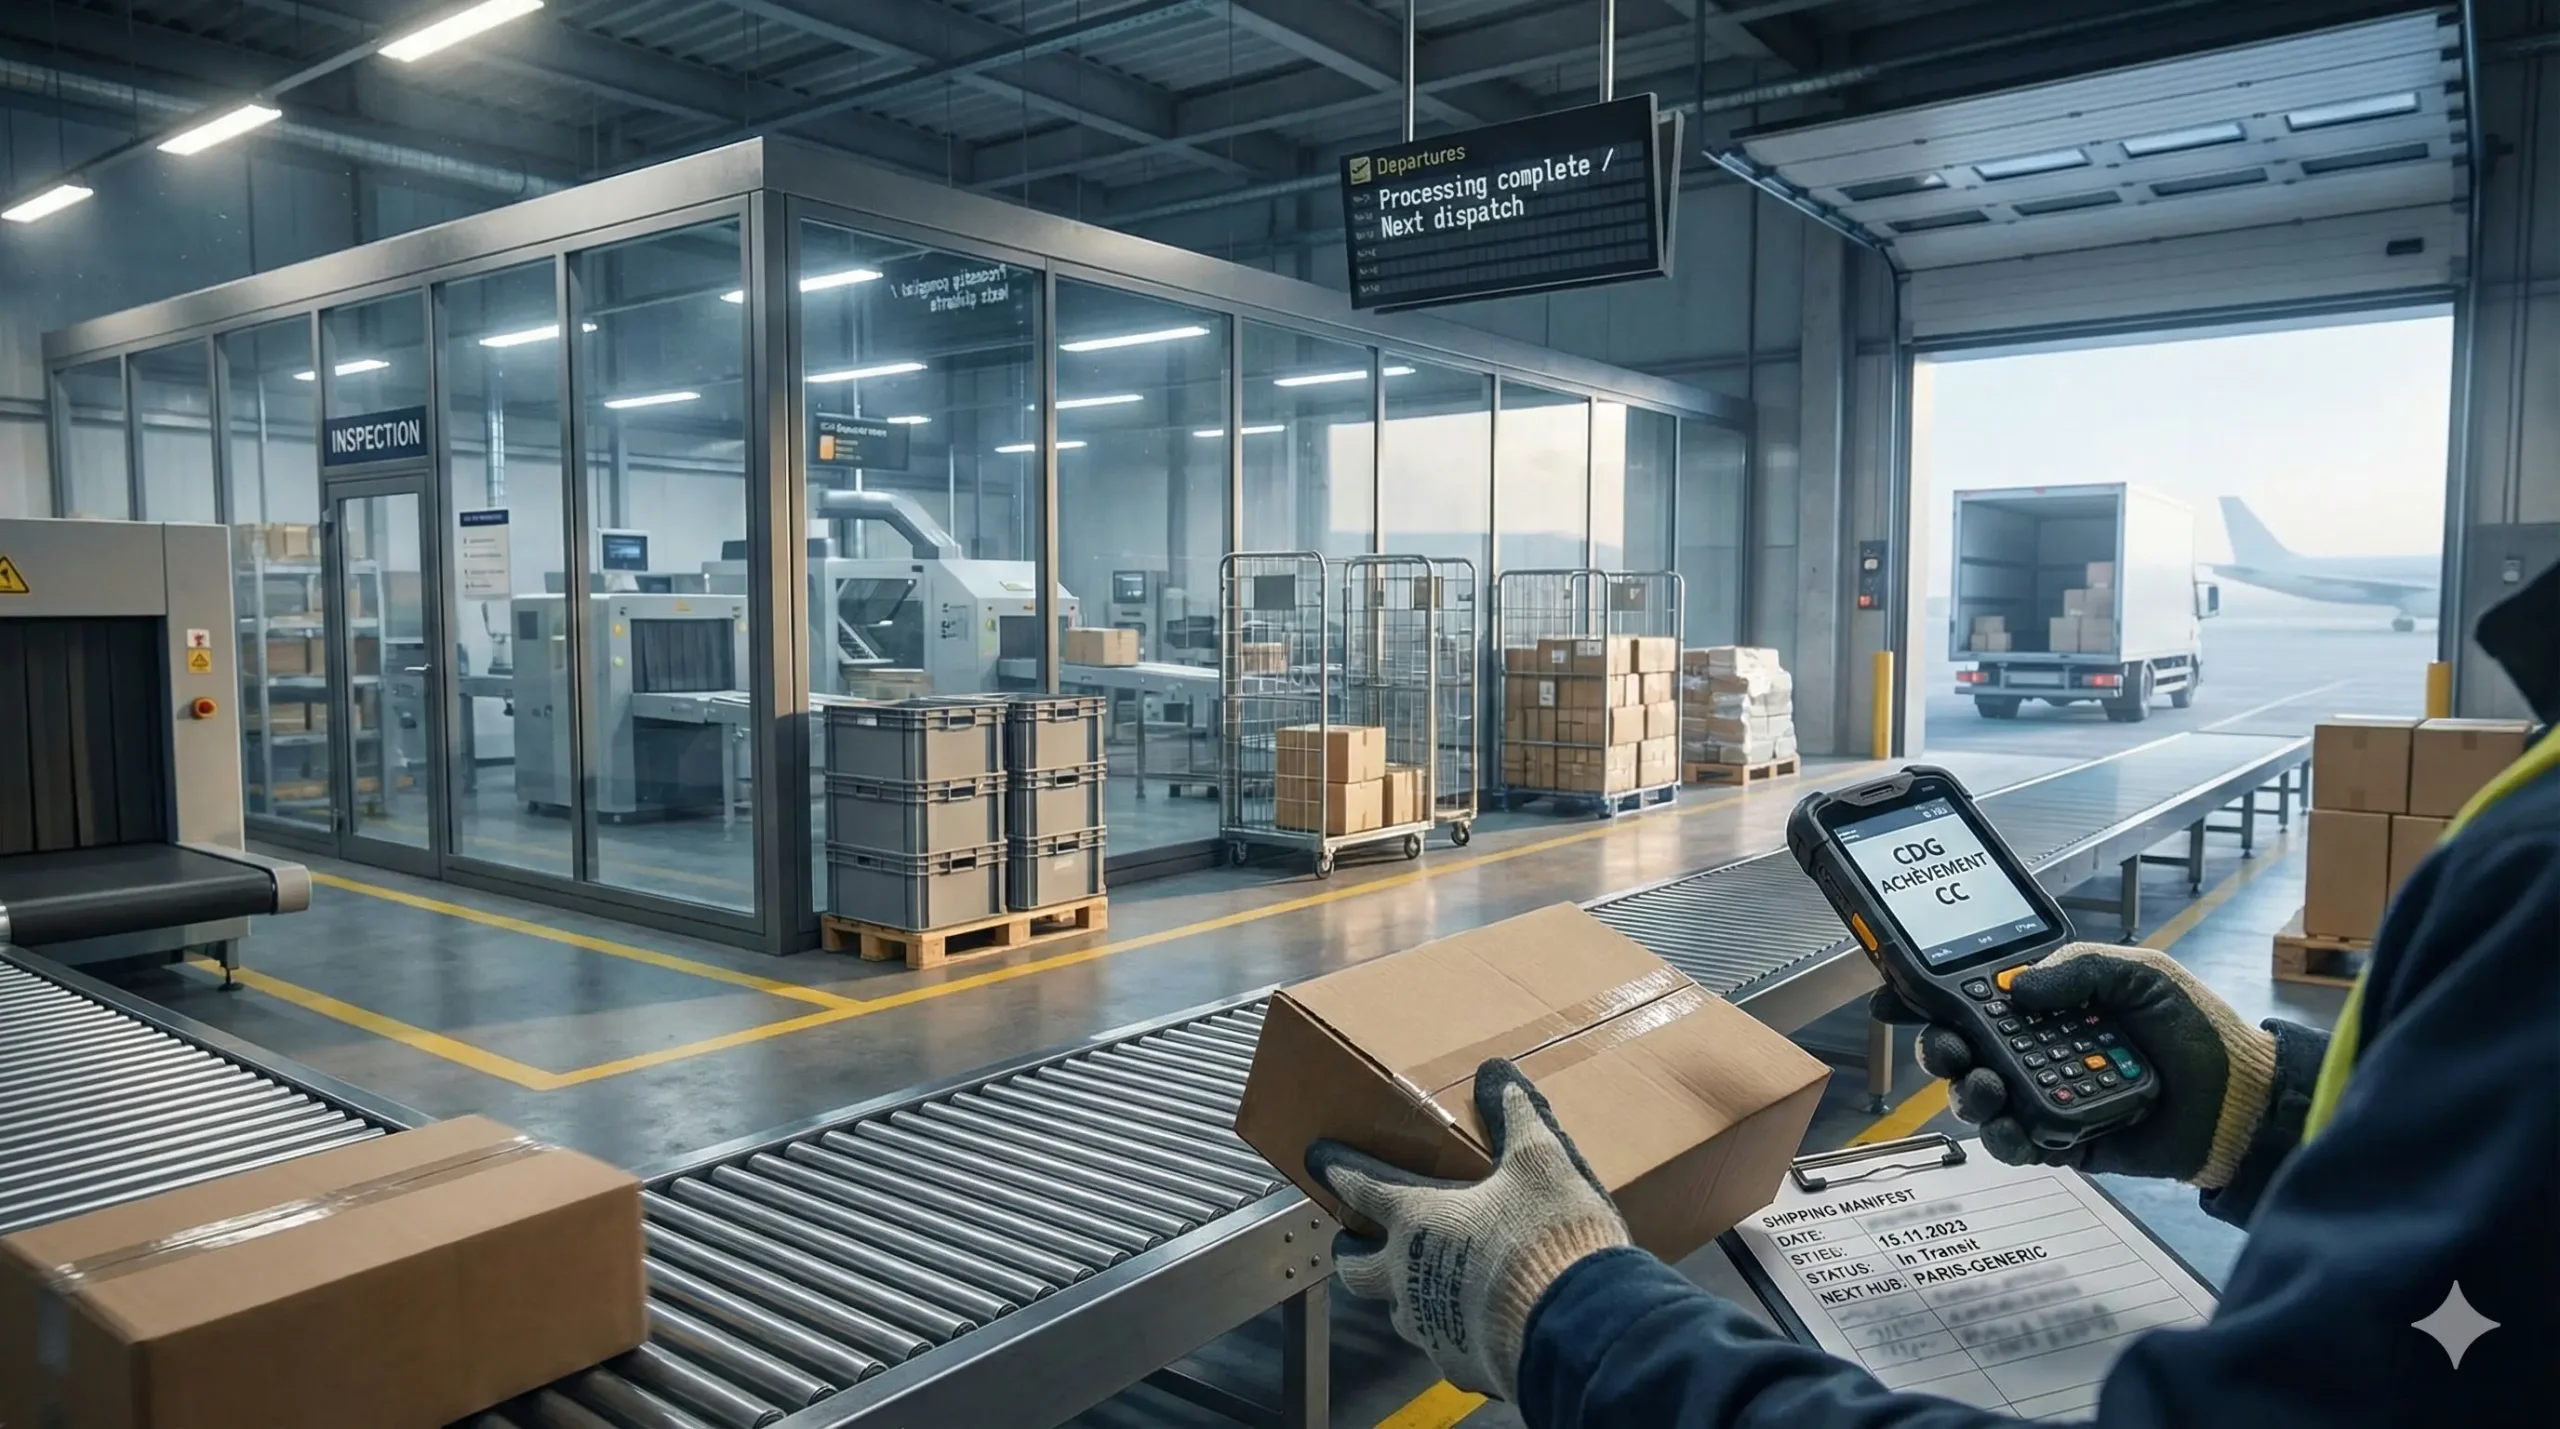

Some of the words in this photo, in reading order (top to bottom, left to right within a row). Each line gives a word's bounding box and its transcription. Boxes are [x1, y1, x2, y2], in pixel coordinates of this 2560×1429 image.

[1377, 146, 1466, 176] Departures
[1379, 174, 1487, 210] Processing
[1497, 154, 1590, 191] complete
[1381, 210, 1424, 238] Next
[1434, 194, 1524, 230] dispatch
[332, 419, 420, 453] INSPECTION
[1893, 837, 1946, 865] CDG
[1881, 852, 1988, 894] ACHÈVEMENT
[1935, 882, 1971, 905] CC
[1762, 1205, 1837, 1228] SHIPPING
[1838, 1188, 1916, 1214] MANIFEST
[1777, 1230, 1826, 1248] DATE:
[1879, 1219, 1968, 1248] 15.11.2023
[1806, 1262, 1875, 1284] STATUS:
[1896, 1254, 1917, 1266] In
[1918, 1238, 1981, 1262] Transit
[1820, 1285, 1864, 1305] NEXT
[1865, 1277, 1907, 1295] HUB:
[1913, 1246, 2047, 1286] PARIS-GENERIC
